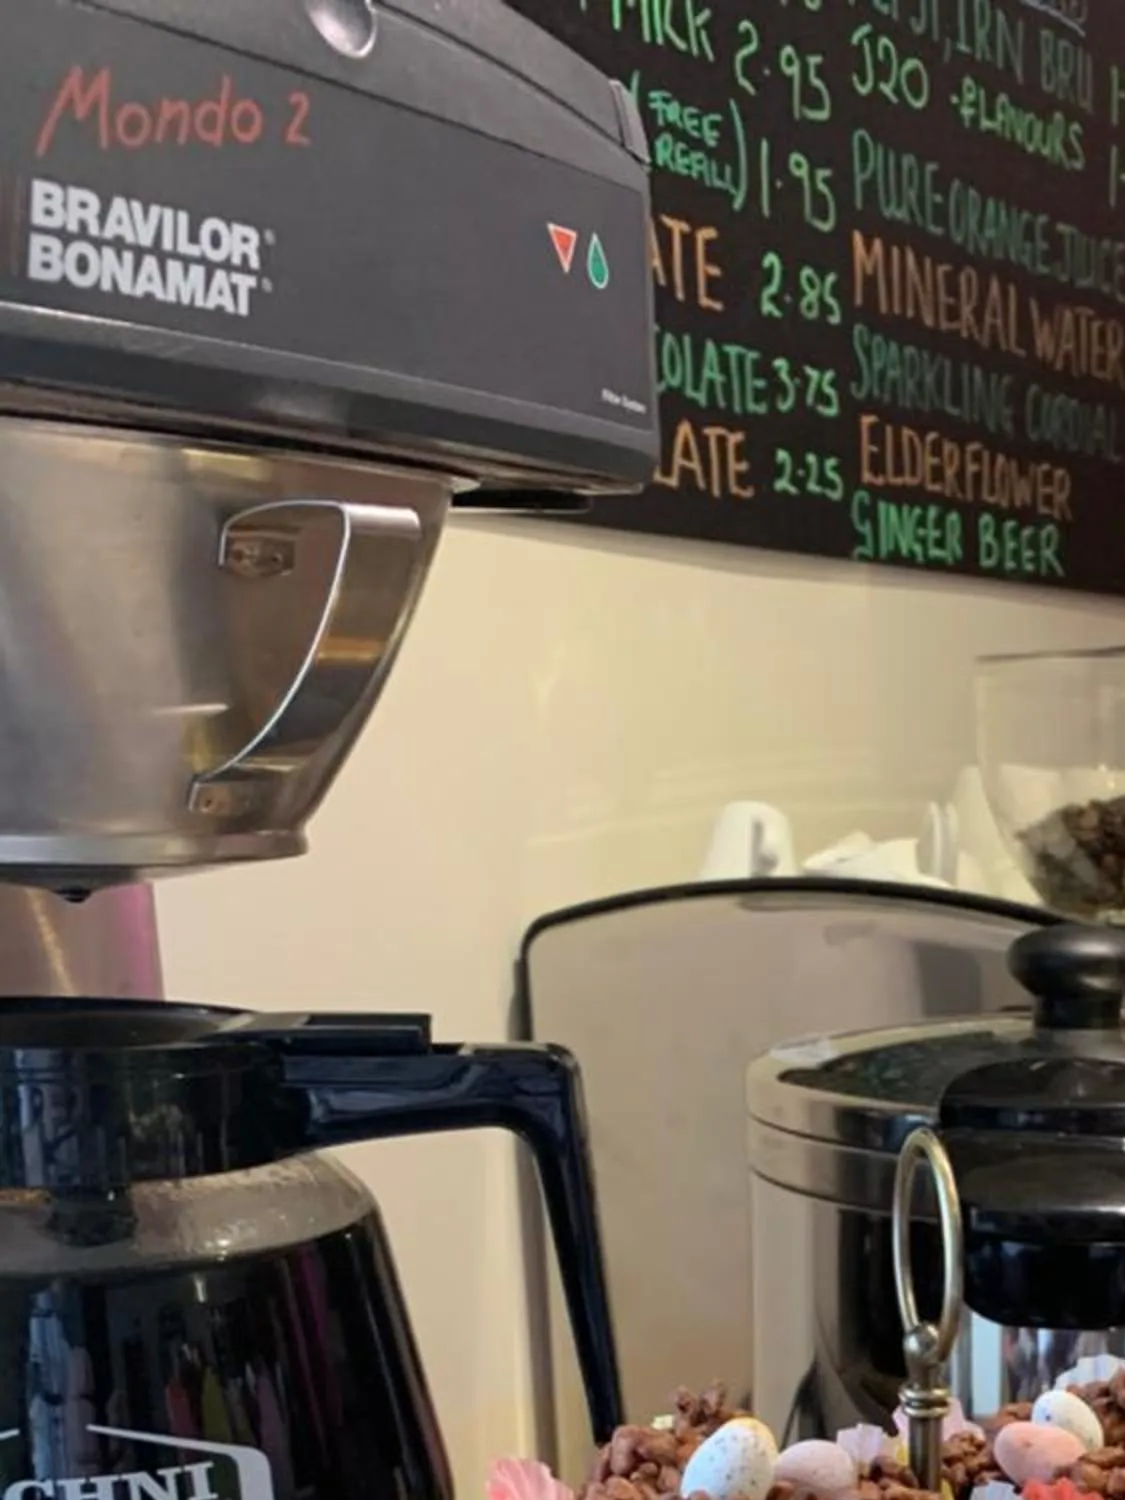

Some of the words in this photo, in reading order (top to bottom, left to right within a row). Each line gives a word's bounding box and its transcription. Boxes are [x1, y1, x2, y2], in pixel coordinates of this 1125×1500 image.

[36, 64, 264, 157] Mondo
[285, 90, 313, 147] 2
[735, 20, 831, 121] 2.95
[1040, 28, 1095, 116] BRU
[30, 177, 262, 270] BRAVILOR
[852, 128, 946, 236] PURE
[948, 178, 1051, 276] ORANGE
[27, 231, 259, 317] BONAMAT
[760, 251, 842, 326] 2.85
[852, 229, 1027, 357] MINERAL
[1029, 297, 1125, 391] WATER
[655, 328, 768, 415] OLATE
[771, 356, 840, 417] 3.75
[772, 447, 845, 501] 2.25
[859, 413, 1074, 523] ELDERFLOWER
[850, 489, 964, 567] GINGER
[978, 511, 1066, 578] BEER
